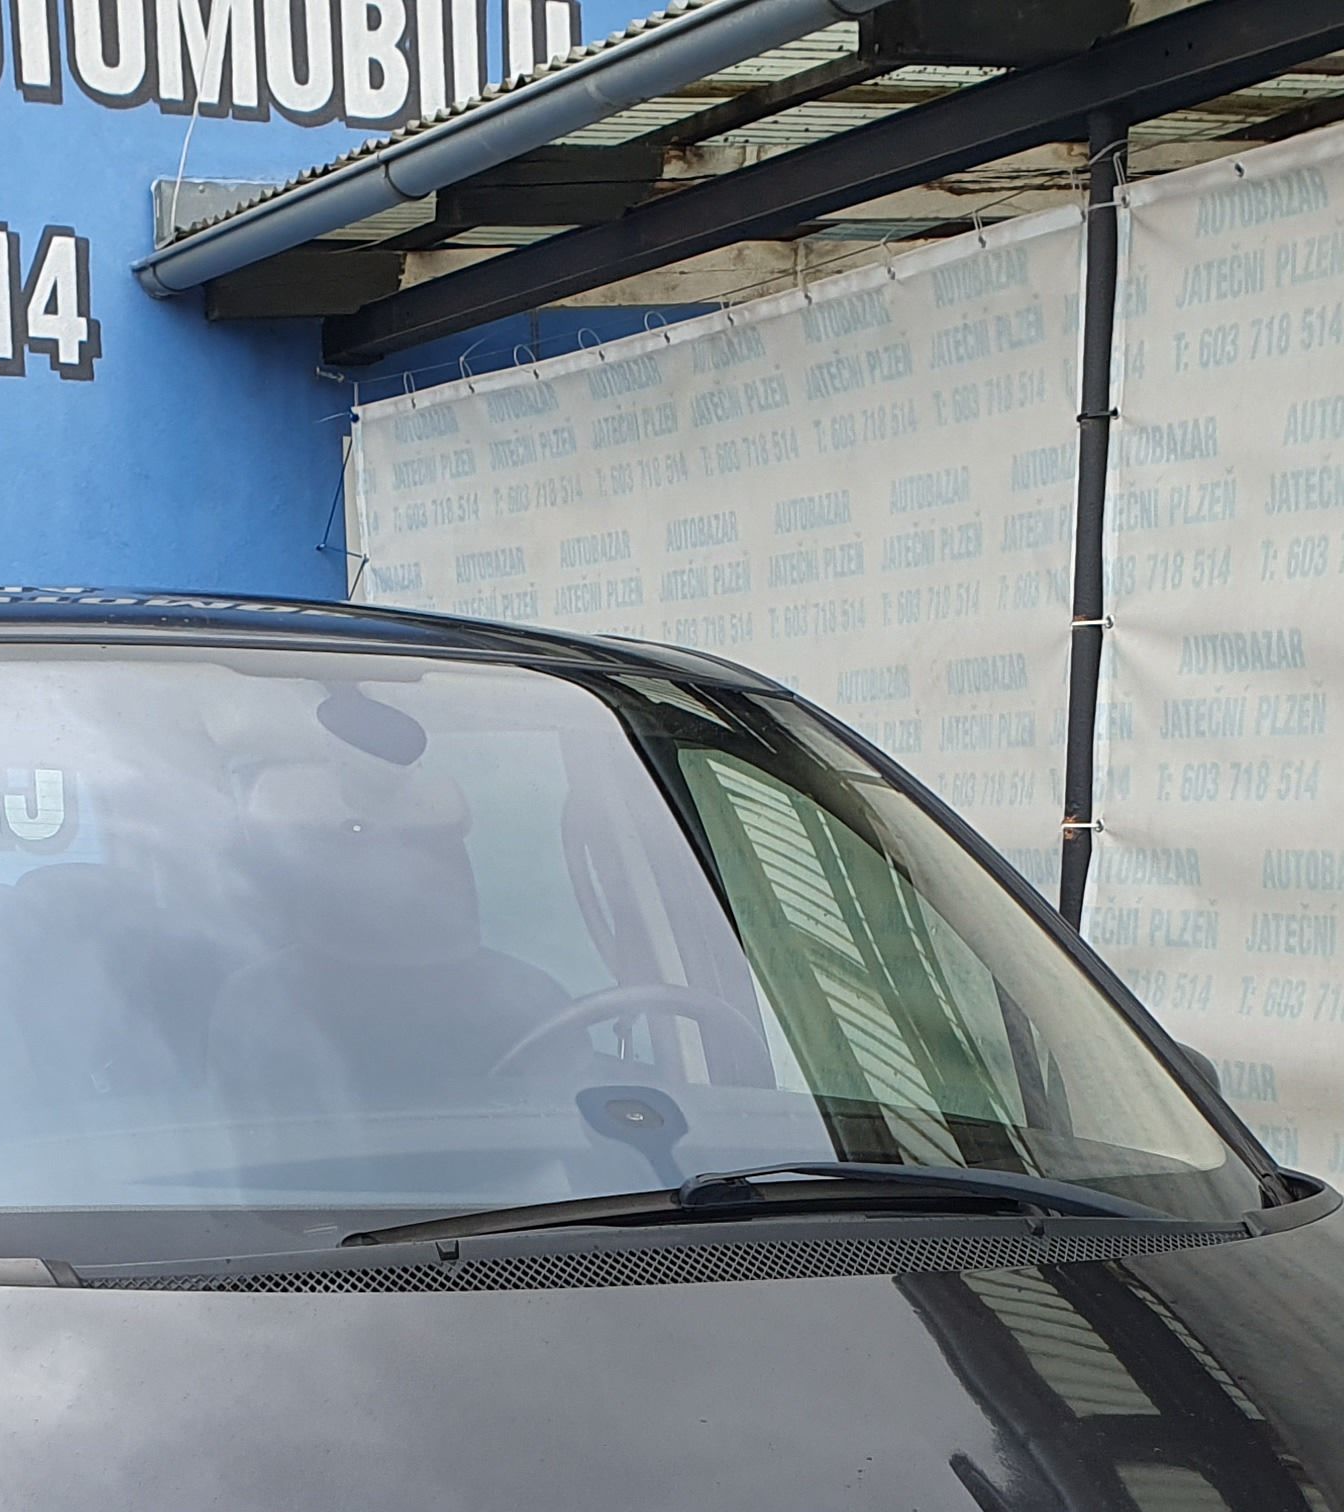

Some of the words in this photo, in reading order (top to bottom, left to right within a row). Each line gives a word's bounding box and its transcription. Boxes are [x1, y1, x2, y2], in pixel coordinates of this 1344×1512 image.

[1196, 165, 1329, 237] AUTOBAZAR
[1176, 238, 1264, 309] JATEČNÍ
[1179, 627, 1306, 676] AUTOBAZAR
[1160, 683, 1250, 739] JATEČNÍ
[1257, 679, 1326, 736] PLZEŇ
[1244, 901, 1337, 957] JATEČNÍ
